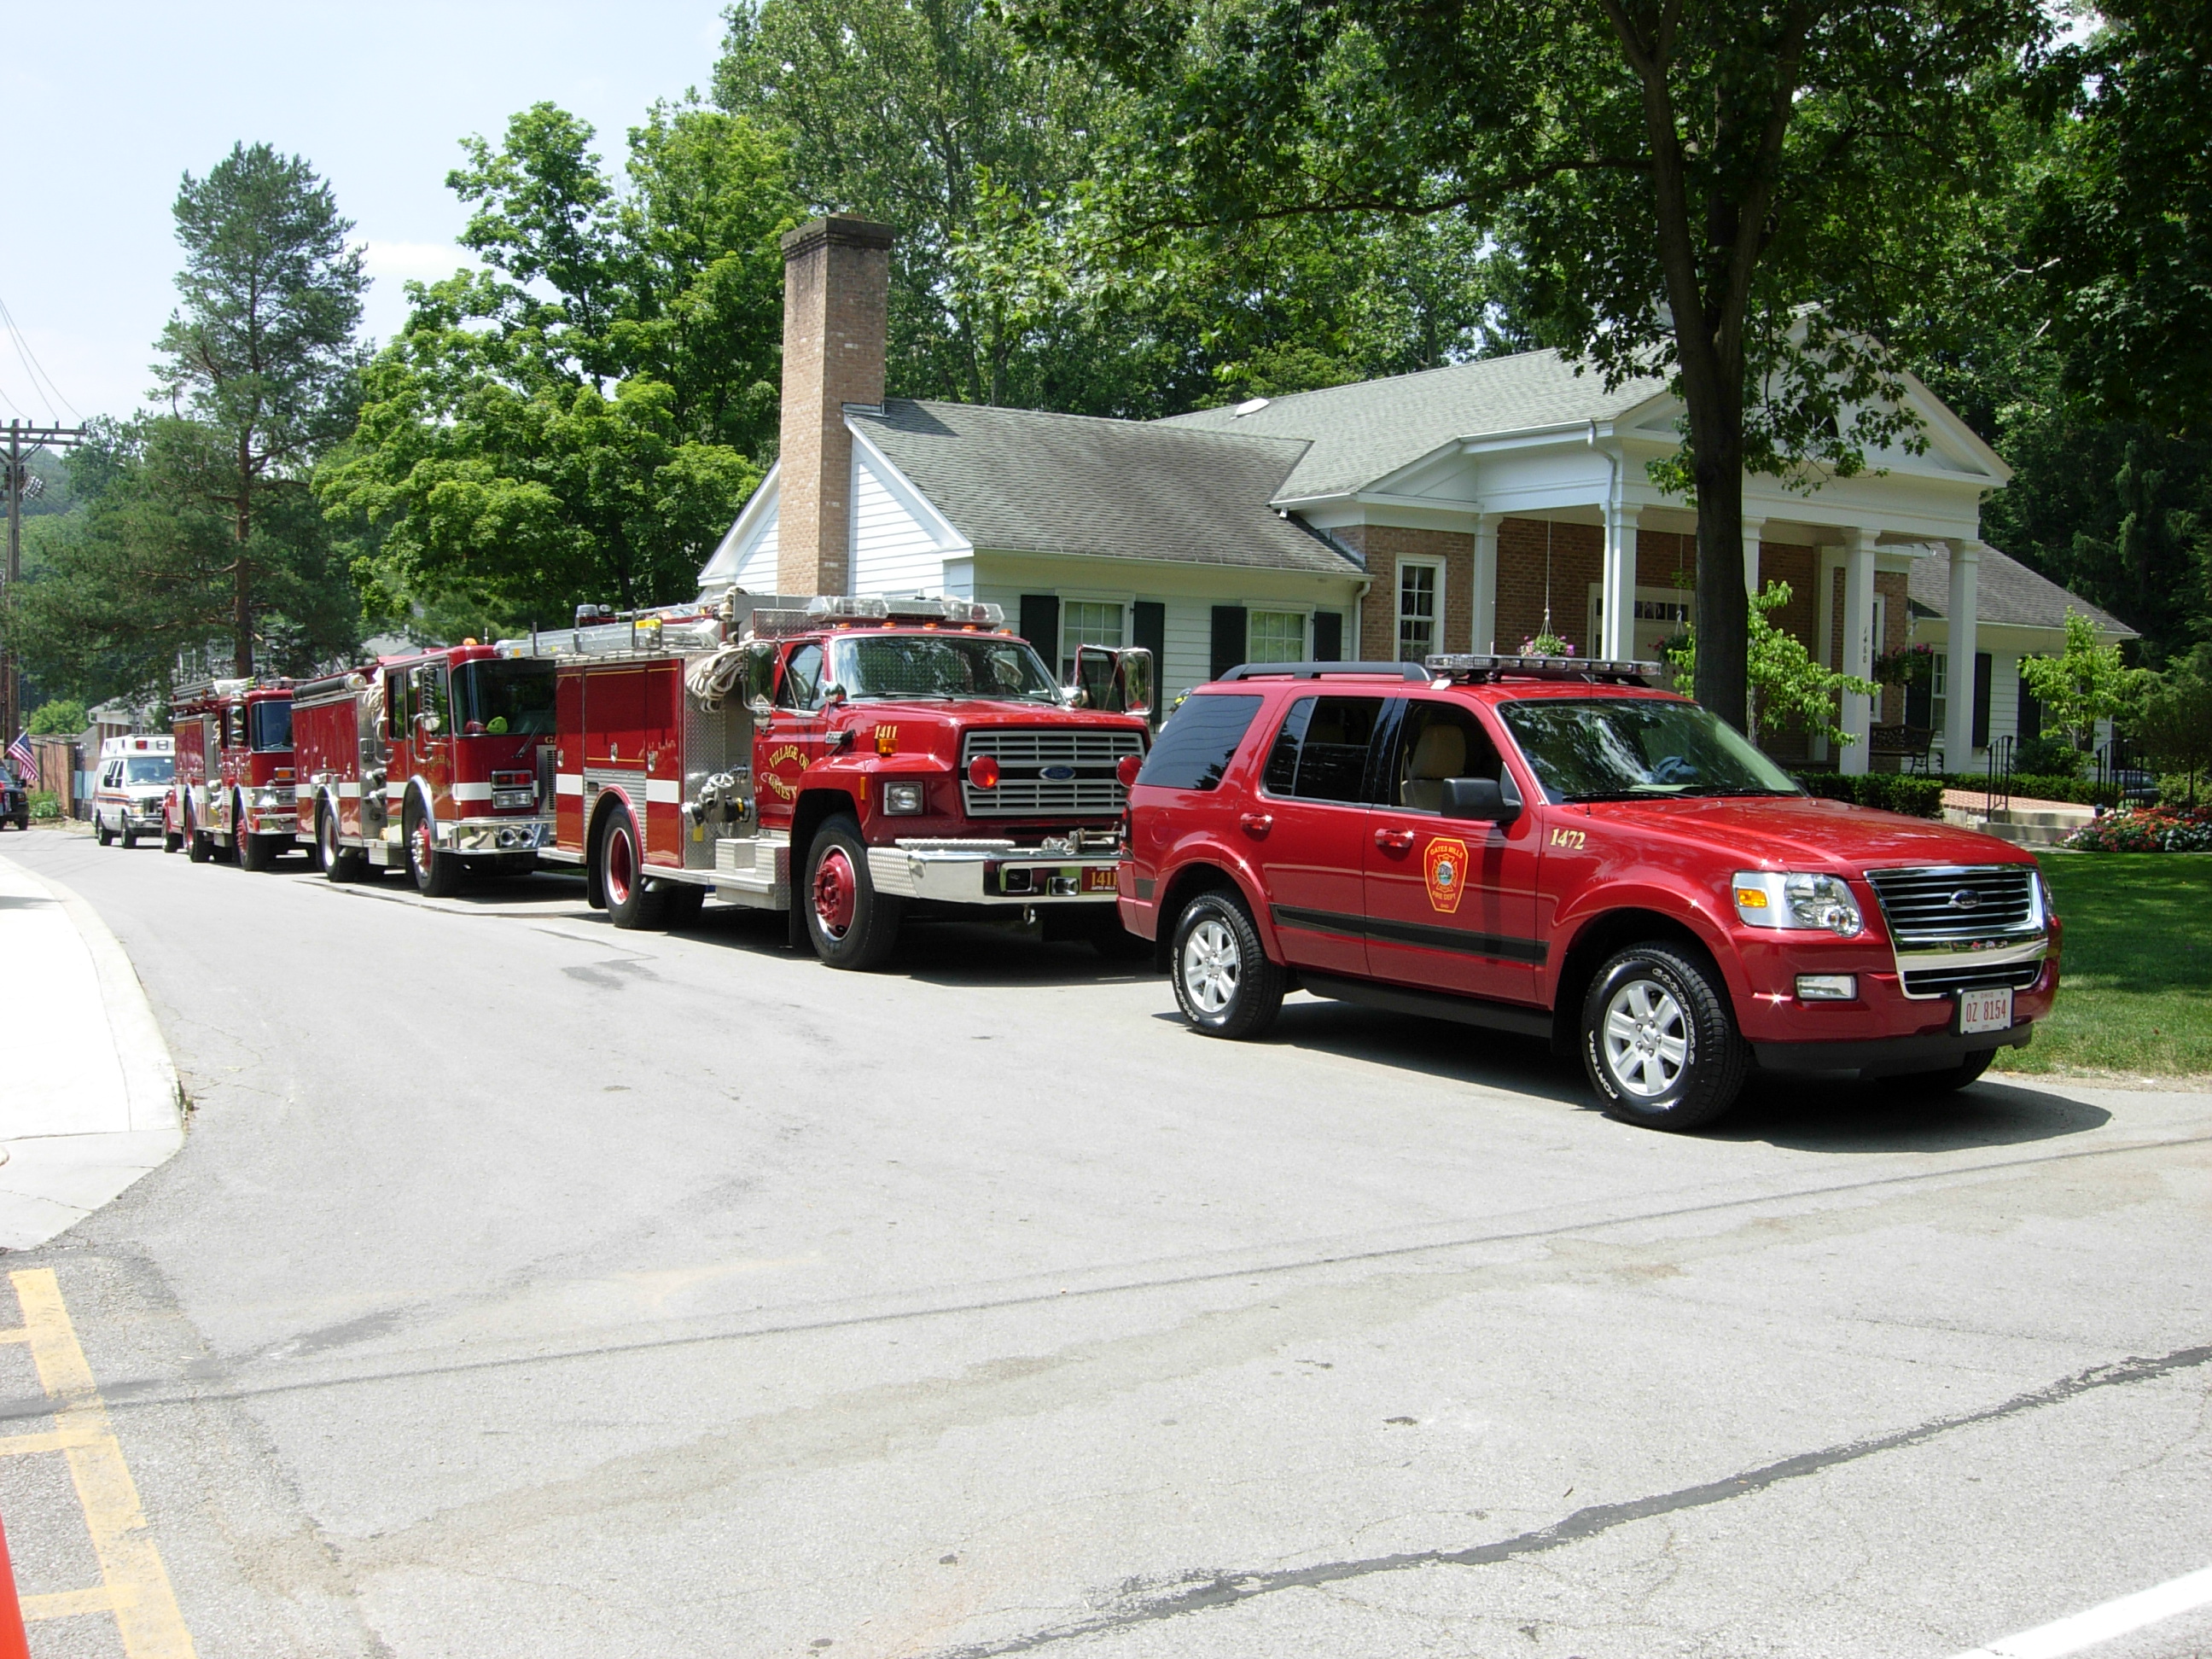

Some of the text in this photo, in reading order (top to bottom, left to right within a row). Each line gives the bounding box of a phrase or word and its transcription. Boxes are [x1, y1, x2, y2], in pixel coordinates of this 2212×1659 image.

[874, 725, 898, 740] 1411
[769, 744, 799, 769] VILLAGE
[1550, 828, 1586, 850] 1472
[1429, 845, 1448, 856] GATES
[1447, 846, 1464, 859] MILLS
[1091, 871, 1117, 886] 1411
[1651, 968, 1697, 1065] GOODYEAR
[1983, 999, 2006, 1021] 8154
[1587, 1030, 1619, 1099] FORTERA
